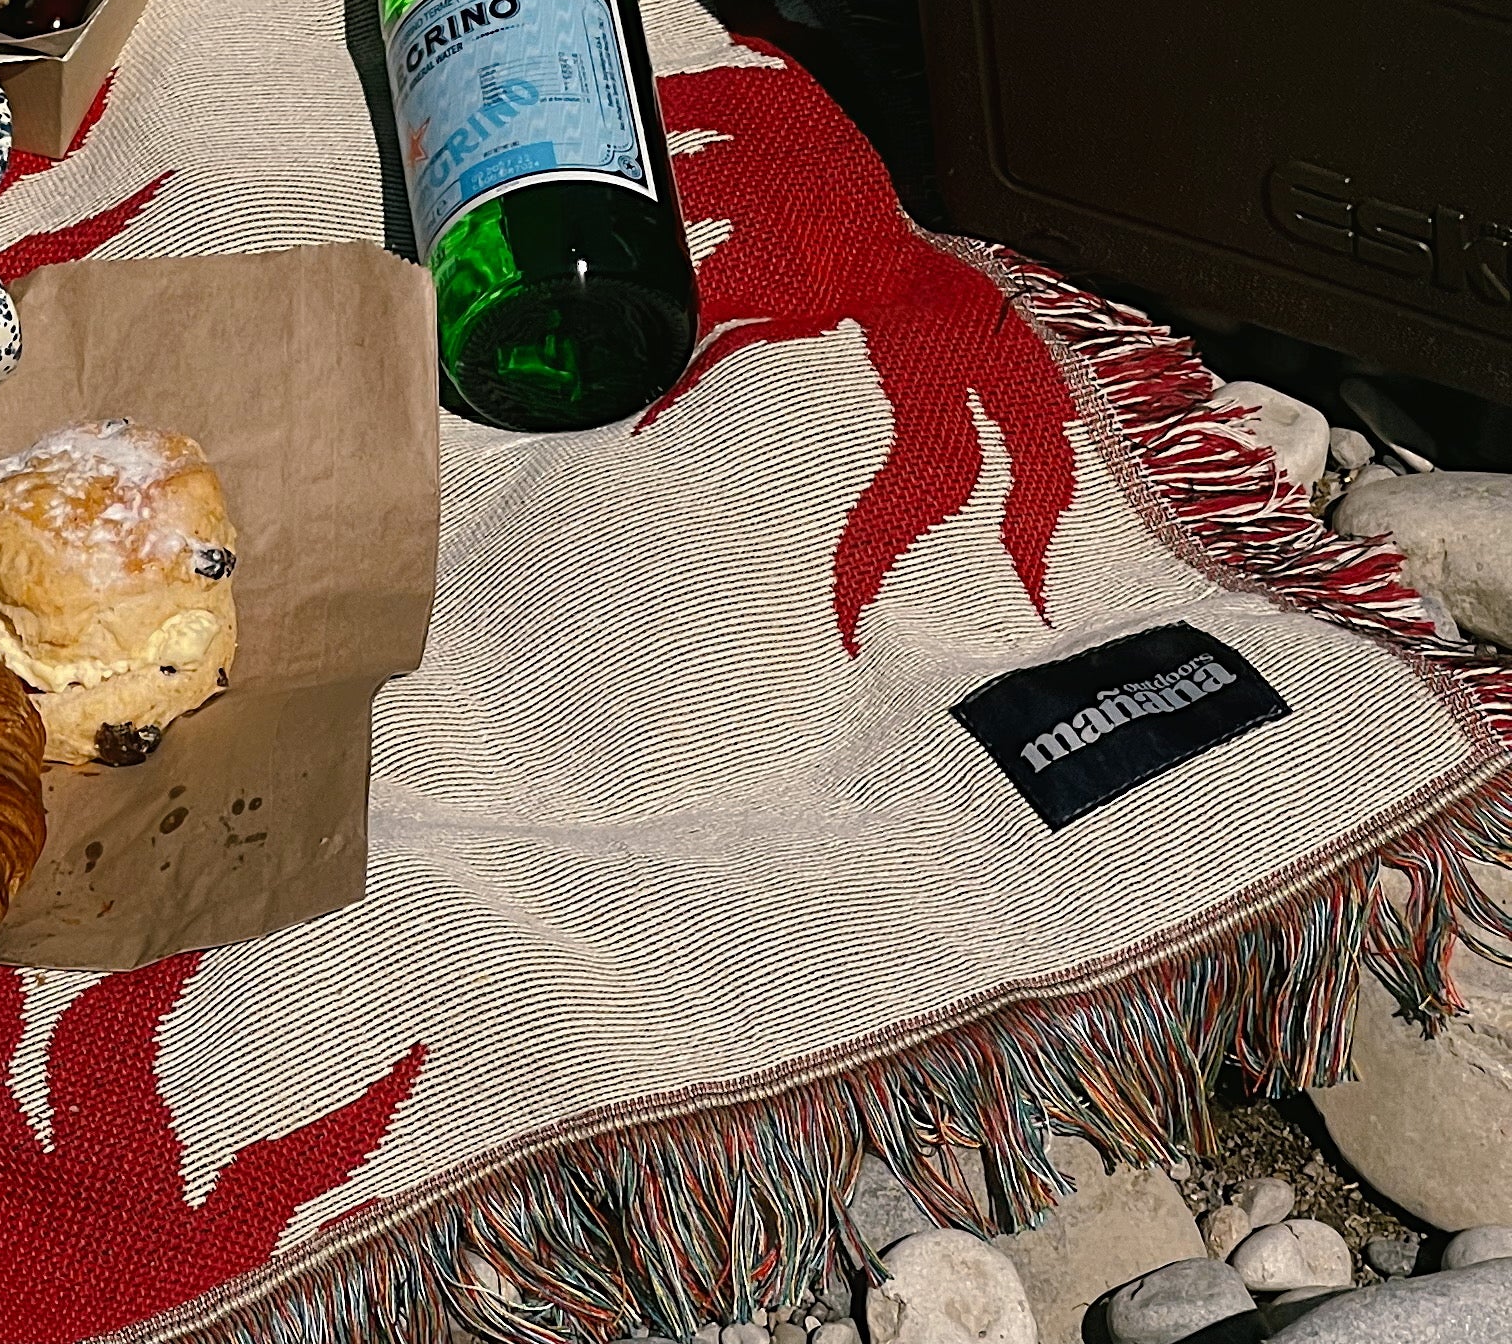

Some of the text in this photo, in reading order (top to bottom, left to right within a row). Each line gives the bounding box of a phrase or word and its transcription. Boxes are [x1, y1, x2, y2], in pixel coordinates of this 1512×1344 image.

[436, 42, 463, 65] WATER
[1123, 652, 1214, 692] outdoors
[1020, 662, 1237, 774] mañana
